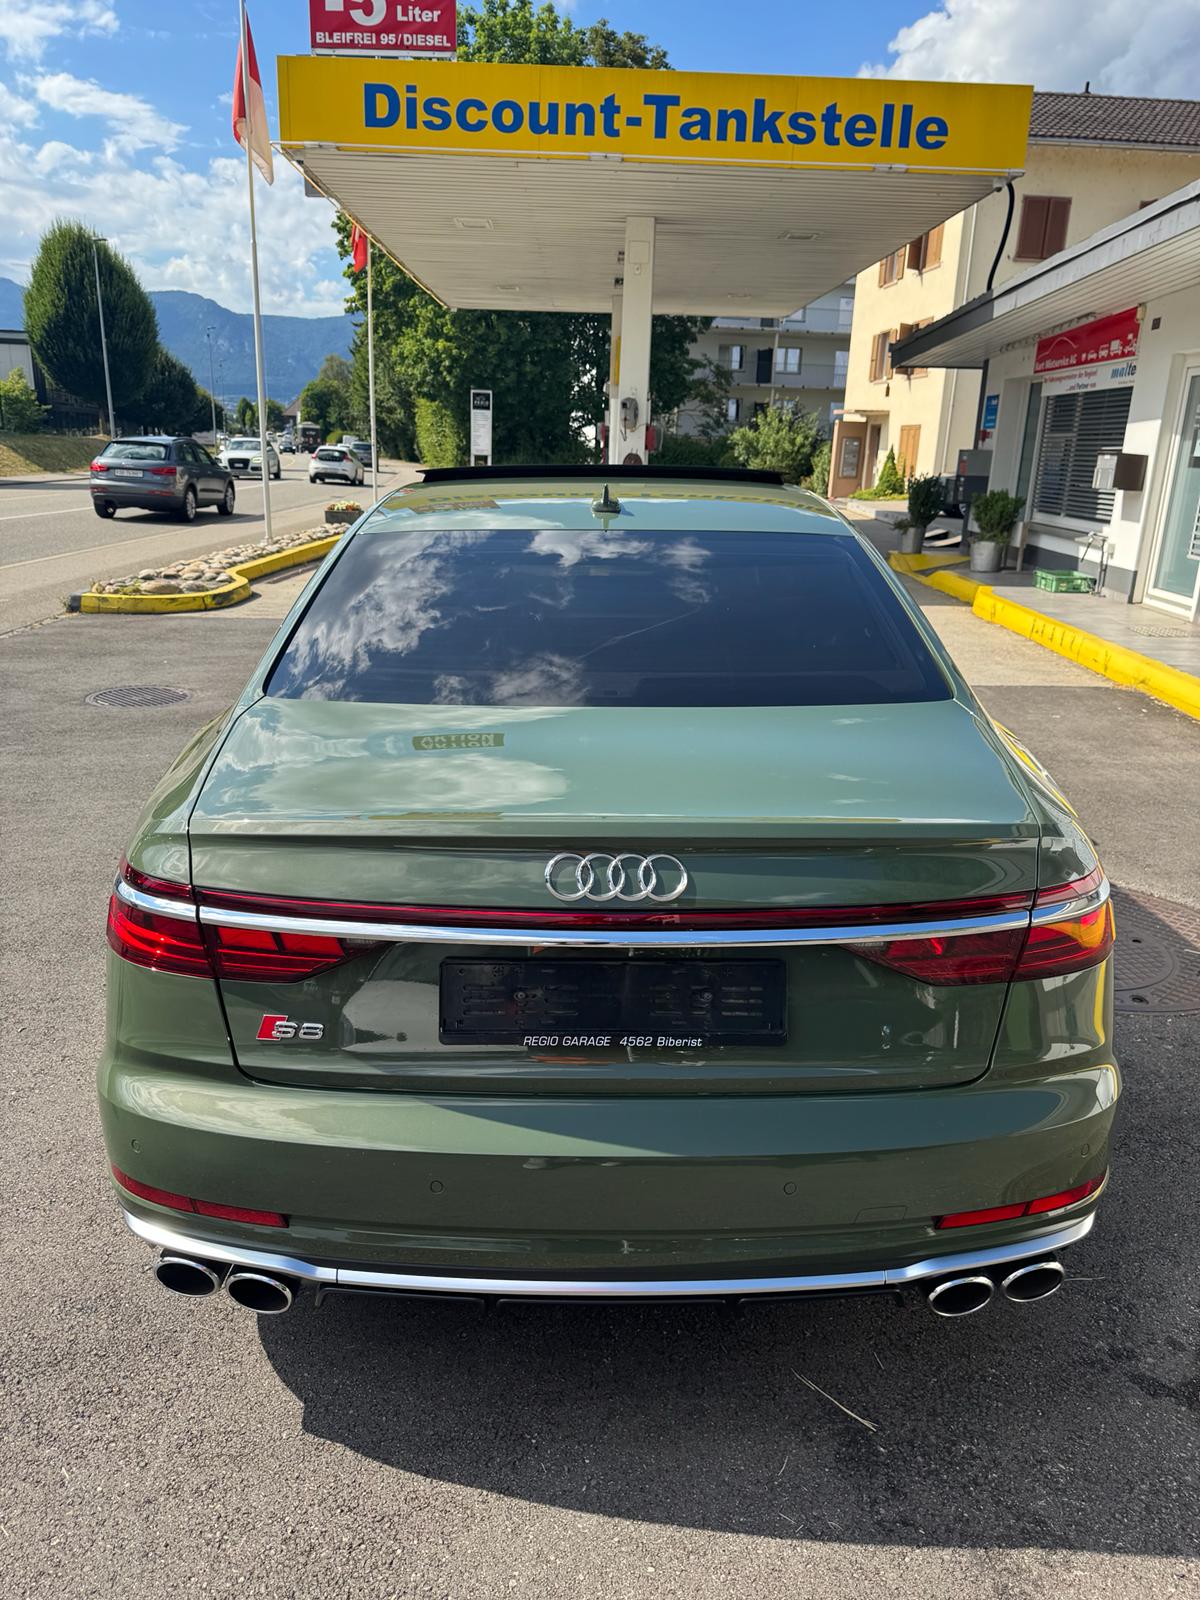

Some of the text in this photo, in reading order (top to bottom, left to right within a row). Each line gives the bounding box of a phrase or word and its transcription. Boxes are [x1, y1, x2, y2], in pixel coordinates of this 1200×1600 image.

[396, 5, 441, 22] Liter
[315, 31, 376, 44] BLEIFREI
[363, 82, 949, 150] Discount-Tankstelle
[271, 1020, 324, 1040] S8
[523, 1035, 703, 1047] REGIO GARAGE 4562 Biberist
